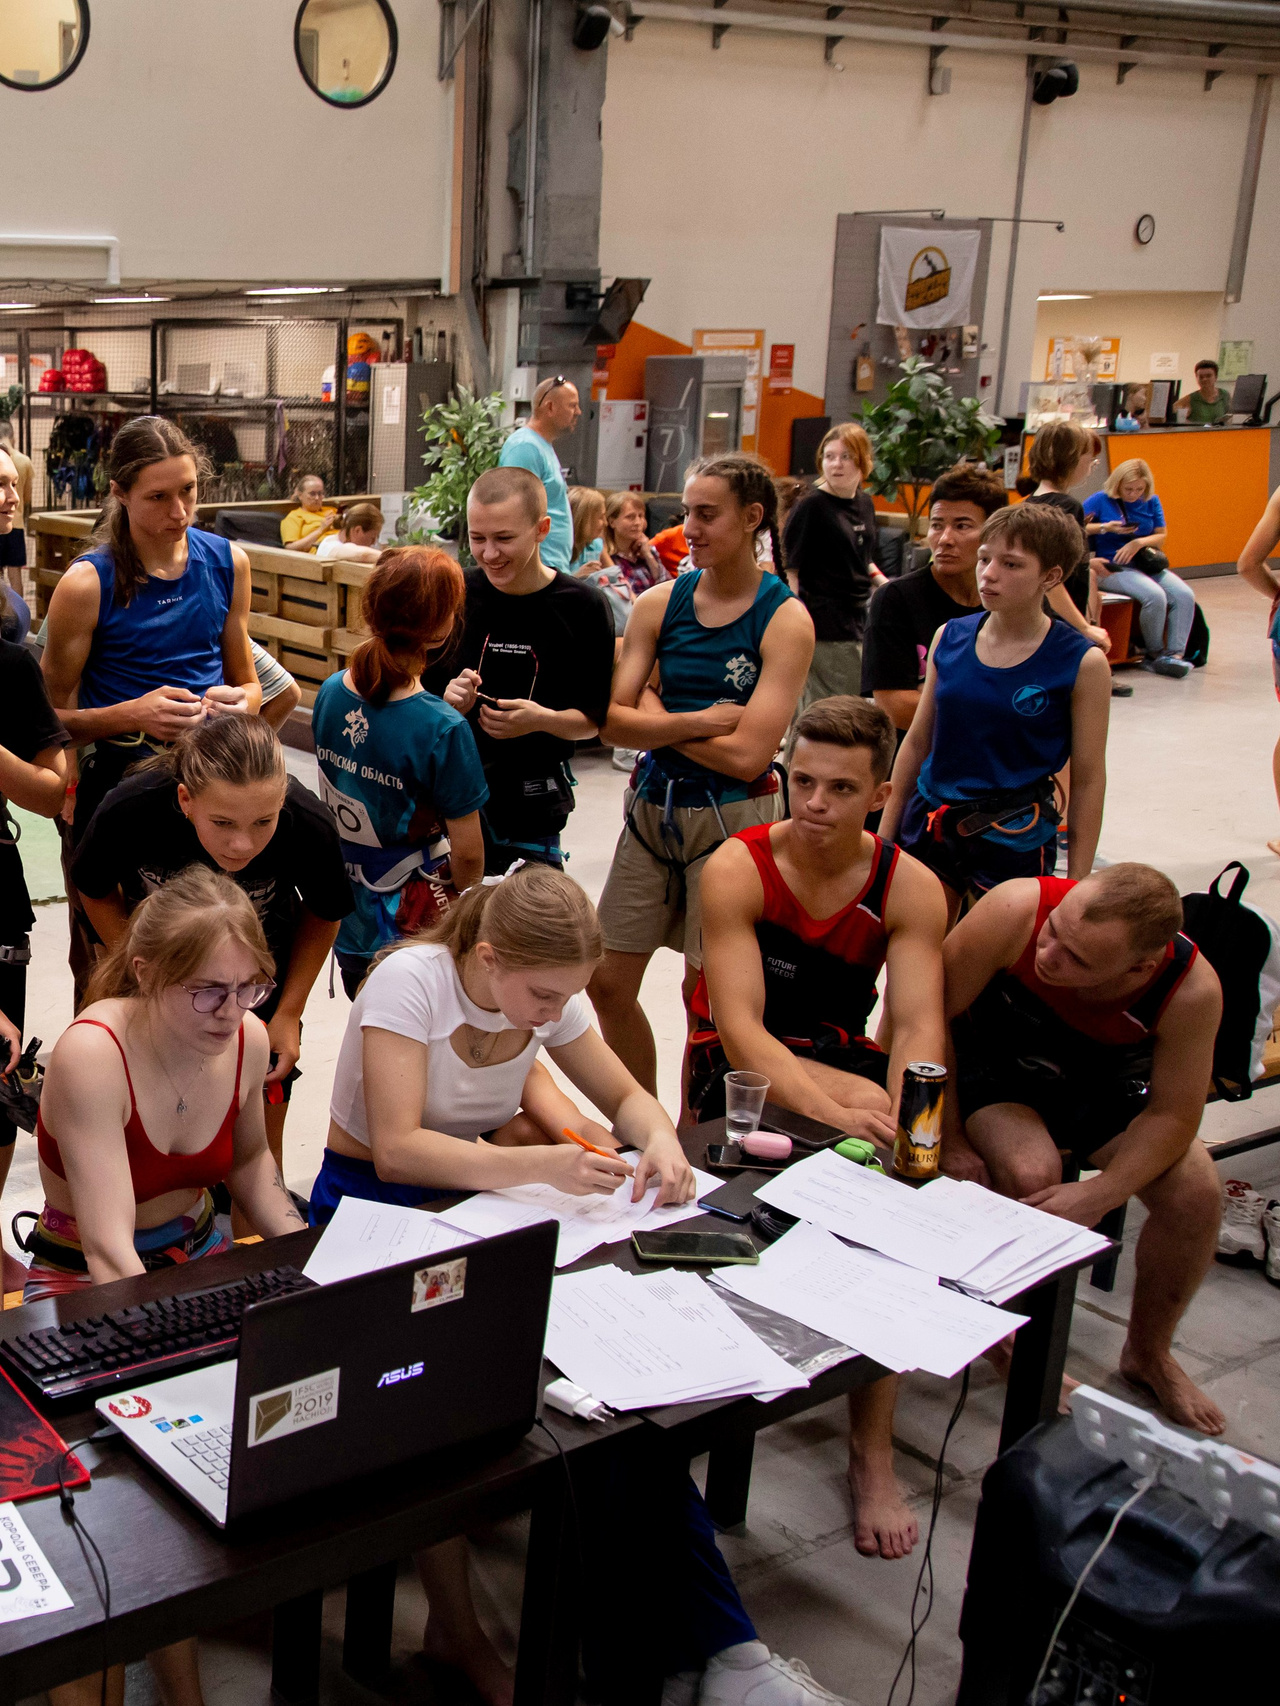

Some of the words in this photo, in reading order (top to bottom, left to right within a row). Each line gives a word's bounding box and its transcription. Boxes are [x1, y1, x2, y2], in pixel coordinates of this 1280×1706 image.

[317, 745, 357, 774] ОГОДСКАЯ
[766, 964, 795, 979] PEEDS
[767, 956, 798, 972] FUTURE
[377, 1361, 424, 1388] ASUS
[294, 1384, 315, 1396] IFSC
[293, 1406, 333, 1425] HACHIOJI
[294, 1392, 333, 1417] 2019
[0, 1516, 23, 1553] КОРОЛЬ
[22, 1554, 51, 1592] СЕВЕРА
